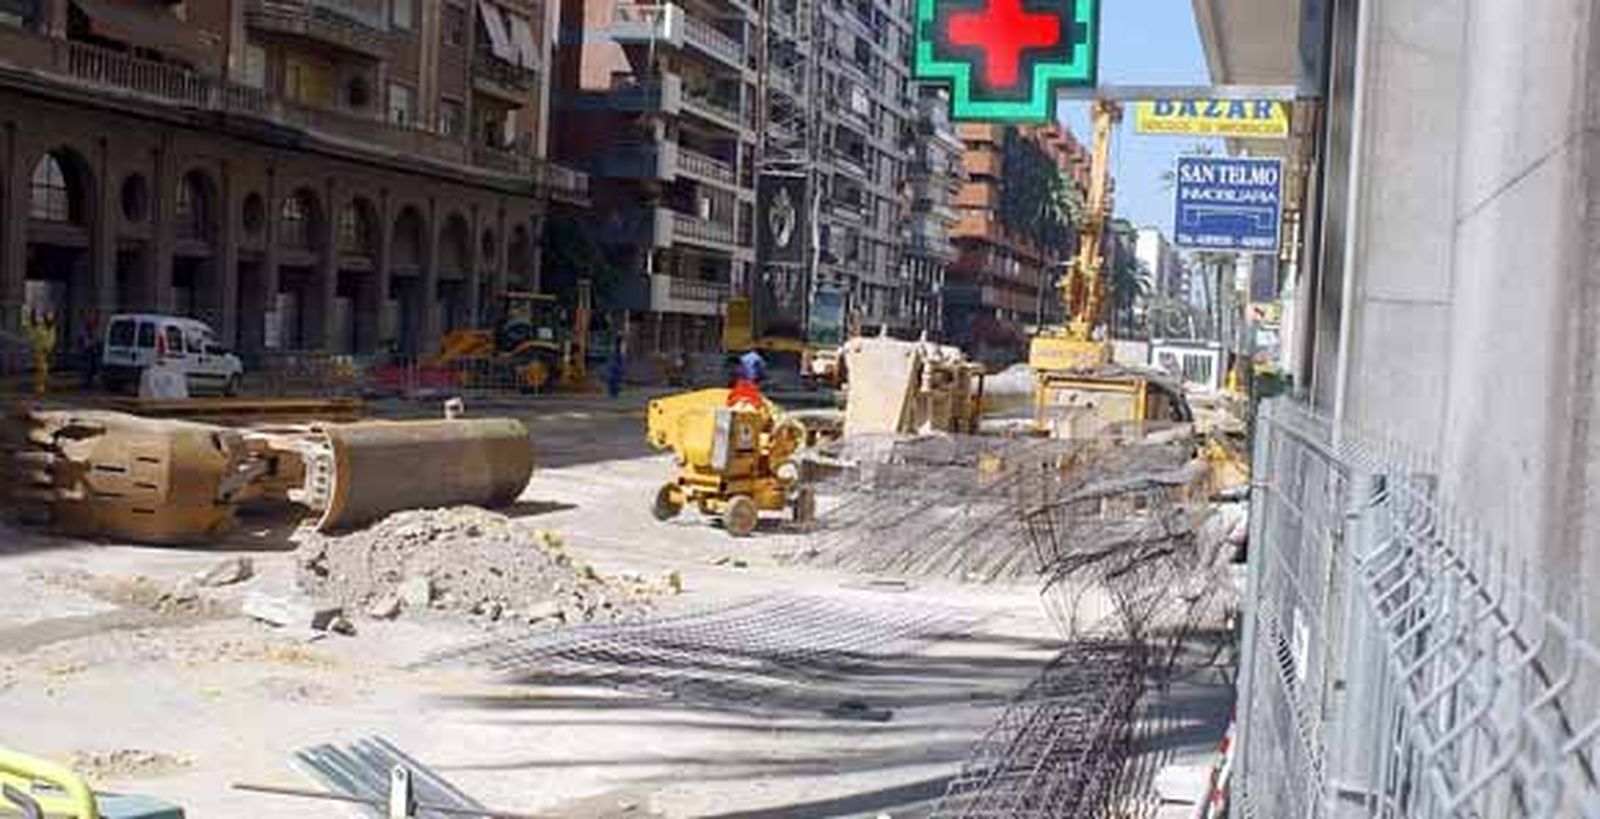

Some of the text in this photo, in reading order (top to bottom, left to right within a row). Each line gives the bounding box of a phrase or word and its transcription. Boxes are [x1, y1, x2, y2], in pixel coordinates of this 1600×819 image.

[1154, 99, 1271, 119] BAZAR
[1180, 163, 1278, 187] SAN TELMO
